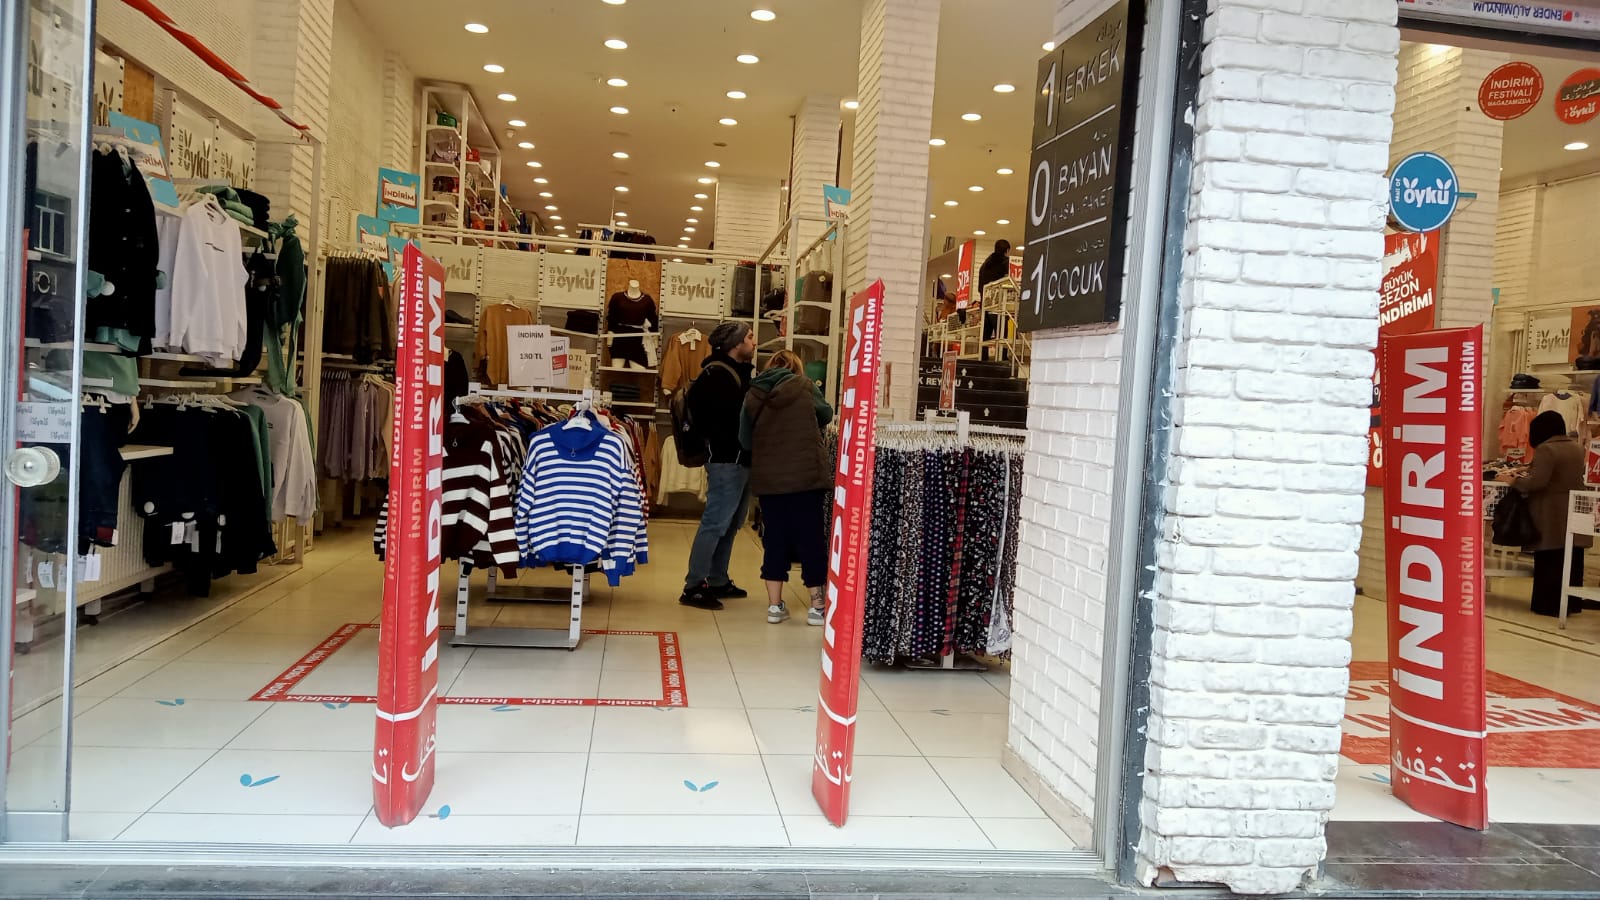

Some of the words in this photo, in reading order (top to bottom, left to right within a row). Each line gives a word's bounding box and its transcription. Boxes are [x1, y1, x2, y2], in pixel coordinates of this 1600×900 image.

[1473, 1, 1531, 19] ALÜMİNYUM
[1533, 8, 1562, 21] ENDER
[1040, 61, 1057, 127] 1
[1064, 40, 1121, 104] ERKEK
[1488, 86, 1532, 100] FESTİVALİ
[1491, 76, 1534, 90] İNDİRİM
[384, 187, 415, 201] İNDİRİM
[1031, 160, 1050, 227] 0
[1058, 144, 1112, 196] BAYAN
[1402, 176, 1452, 208] öykü
[412, 256, 423, 333] İNDİRİM
[556, 265, 596, 293] öykü
[677, 275, 716, 301] öykü
[1021, 254, 1045, 316] -1
[1047, 260, 1106, 310] ÇOCUK
[1379, 278, 1420, 309] SEZON
[1383, 269, 1414, 292] BÜYÜK
[517, 331, 544, 339] İNDİRİM
[411, 338, 424, 430] İNDİRİM
[1458, 340, 1475, 412] İNDİRİM
[421, 275, 442, 673] İNDİRİM
[844, 507, 860, 592] İNDİRİM
[852, 400, 869, 486] İNDİRİM
[861, 298, 876, 373] İNDİRİM
[408, 448, 422, 539] İNDİRİM
[822, 304, 865, 682] İNDİRİM
[1458, 436, 1474, 517] İNDİRİM
[1392, 346, 1449, 701] İNDİRİM
[1458, 535, 1475, 616] İNDİRİM
